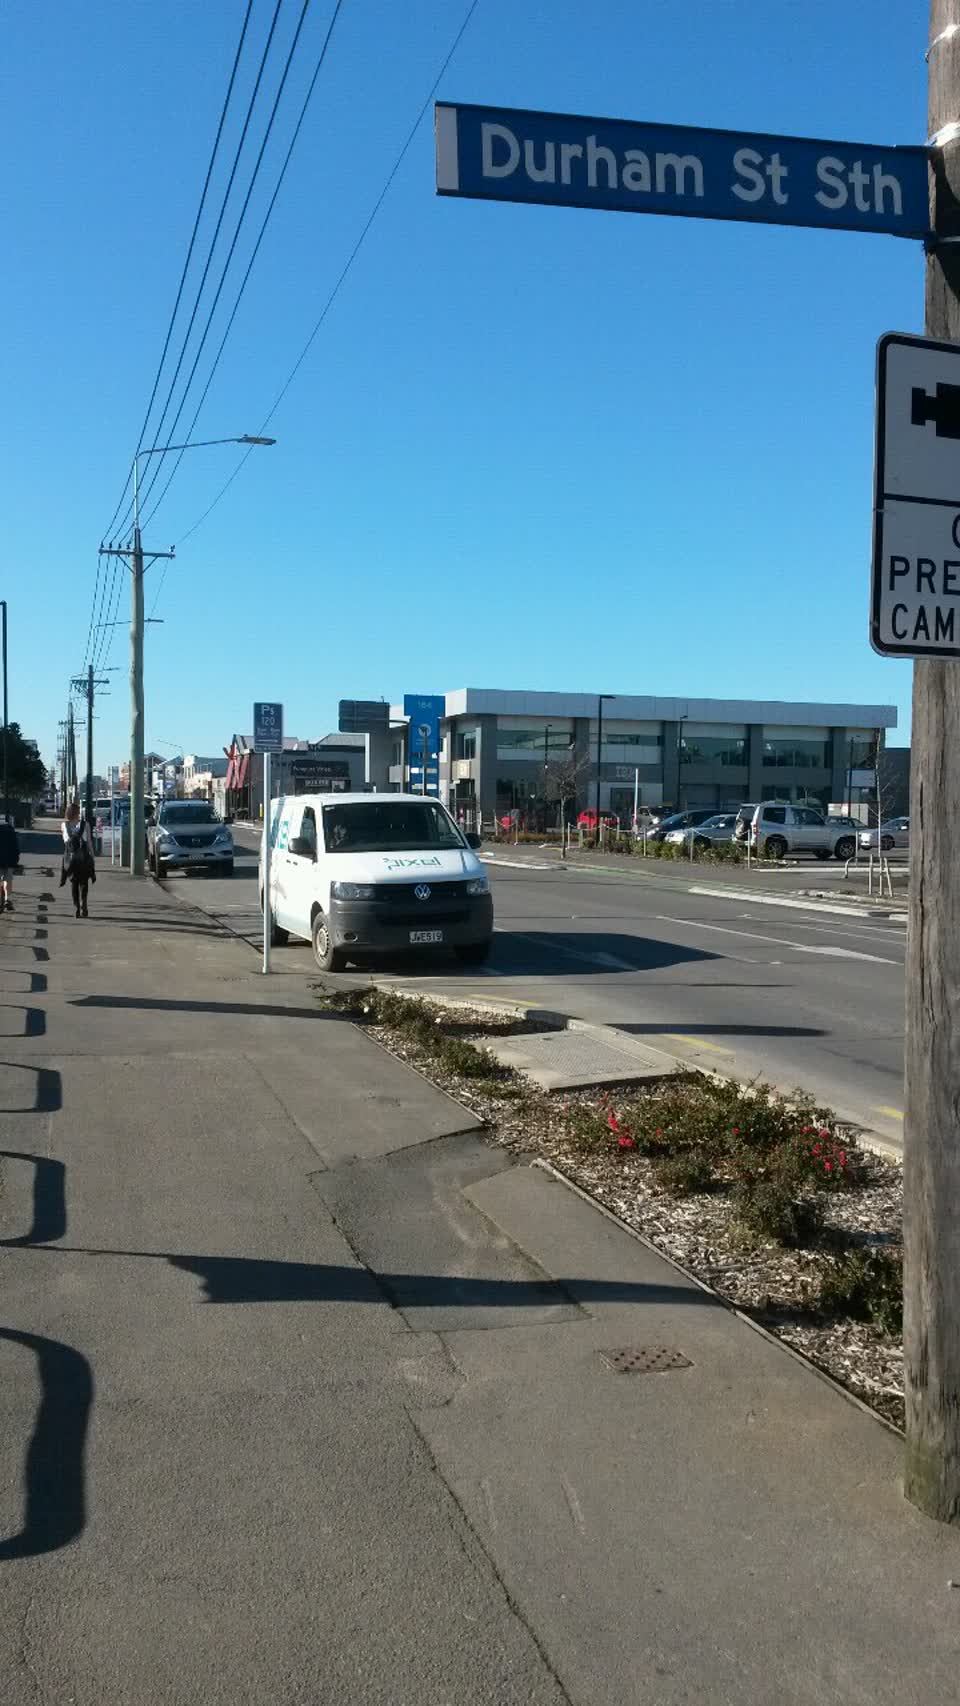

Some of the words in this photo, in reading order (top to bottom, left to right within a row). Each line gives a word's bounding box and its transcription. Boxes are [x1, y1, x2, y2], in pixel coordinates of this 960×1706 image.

[481, 121, 704, 197] Durham
[731, 147, 789, 206] St
[815, 155, 904, 216] Sth
[261, 716, 275, 726] 120
